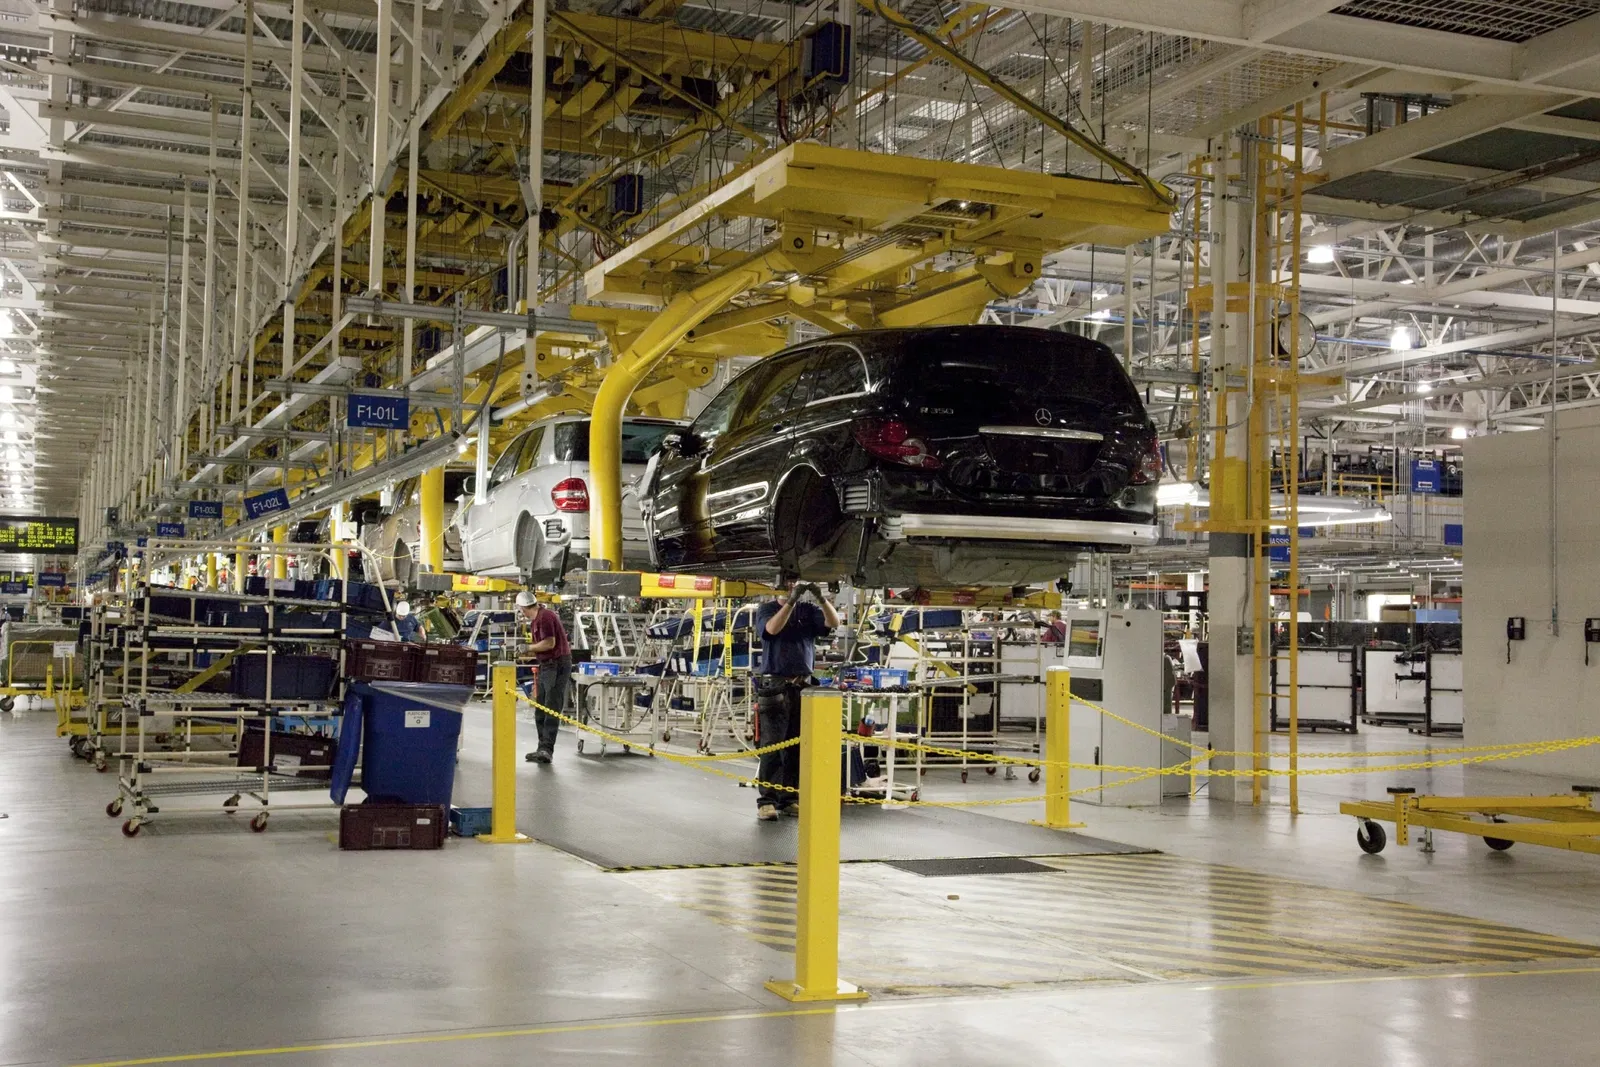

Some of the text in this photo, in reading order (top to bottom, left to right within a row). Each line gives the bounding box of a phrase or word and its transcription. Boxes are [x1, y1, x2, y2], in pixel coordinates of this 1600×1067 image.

[357, 404, 399, 421] F1-01L
[920, 406, 929, 414] R
[194, 505, 218, 515] F1-03L
[252, 497, 282, 513] F1-02L
